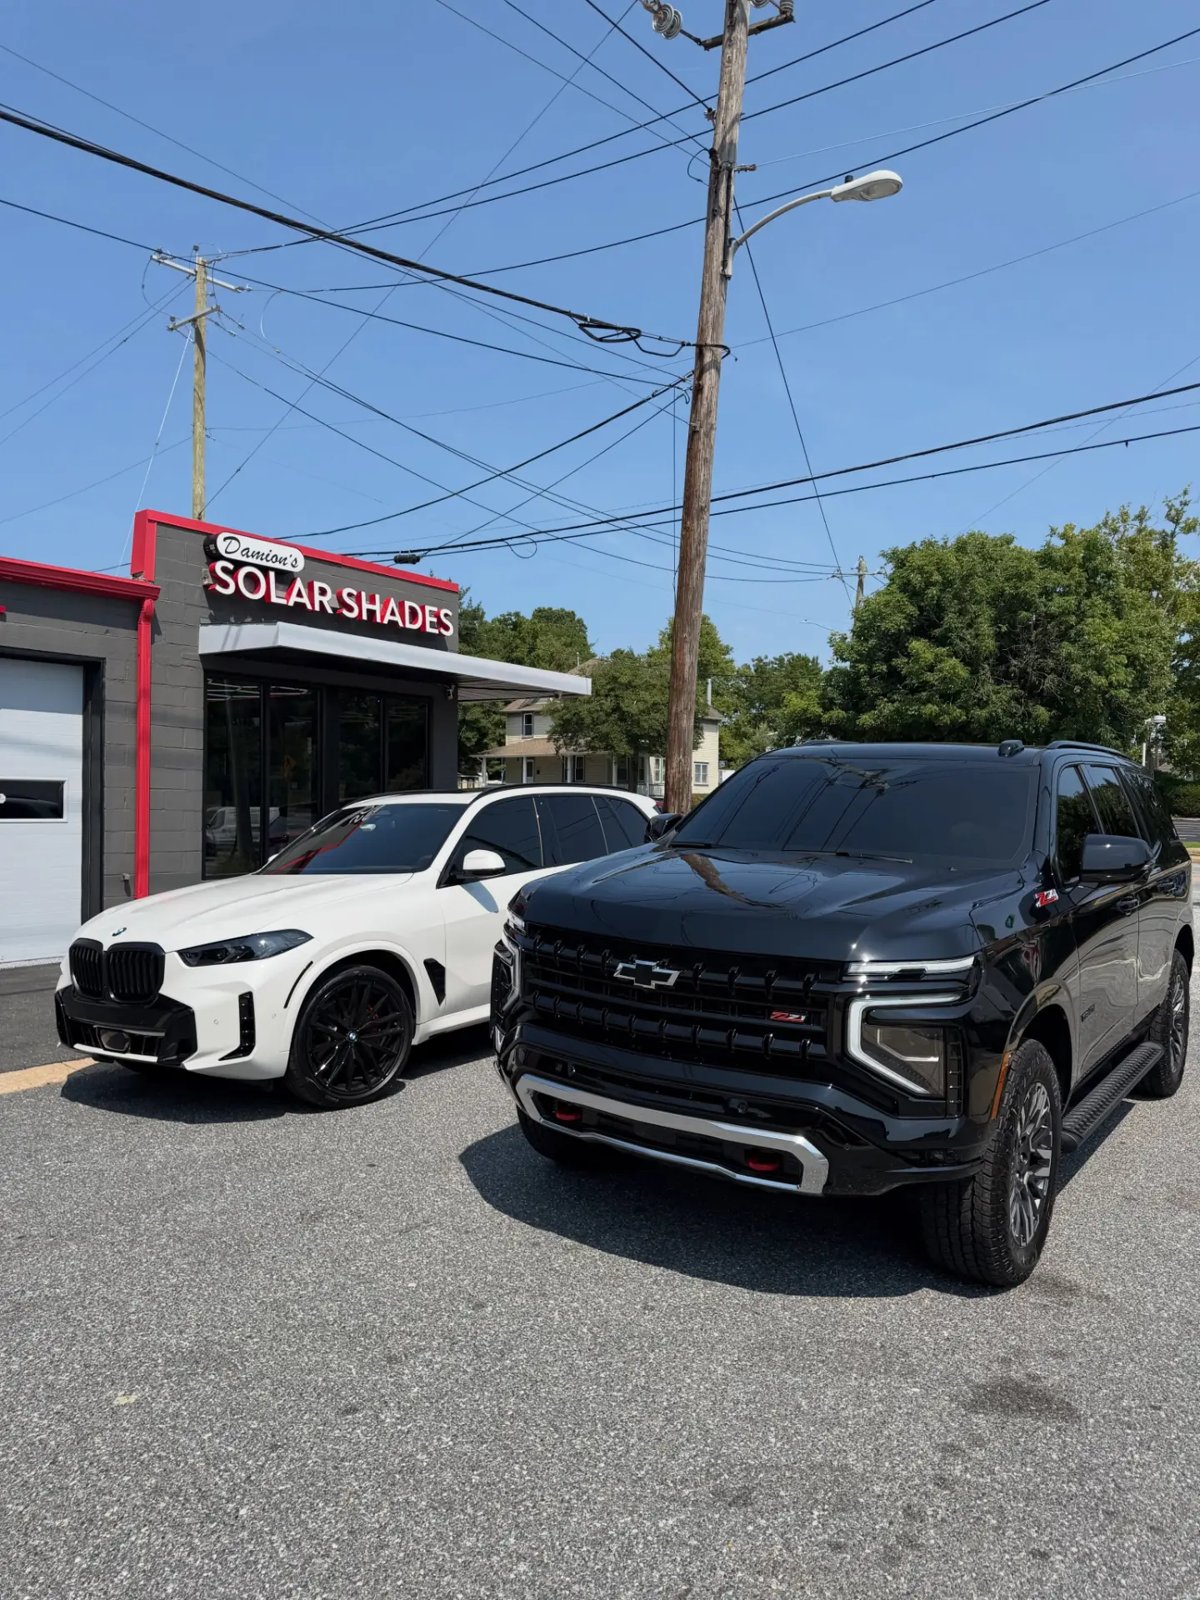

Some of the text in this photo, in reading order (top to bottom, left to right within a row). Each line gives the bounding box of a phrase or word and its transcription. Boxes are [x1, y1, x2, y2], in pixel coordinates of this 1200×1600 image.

[223, 535, 299, 568] Damion's
[211, 560, 455, 637] SOLAR SHADES
